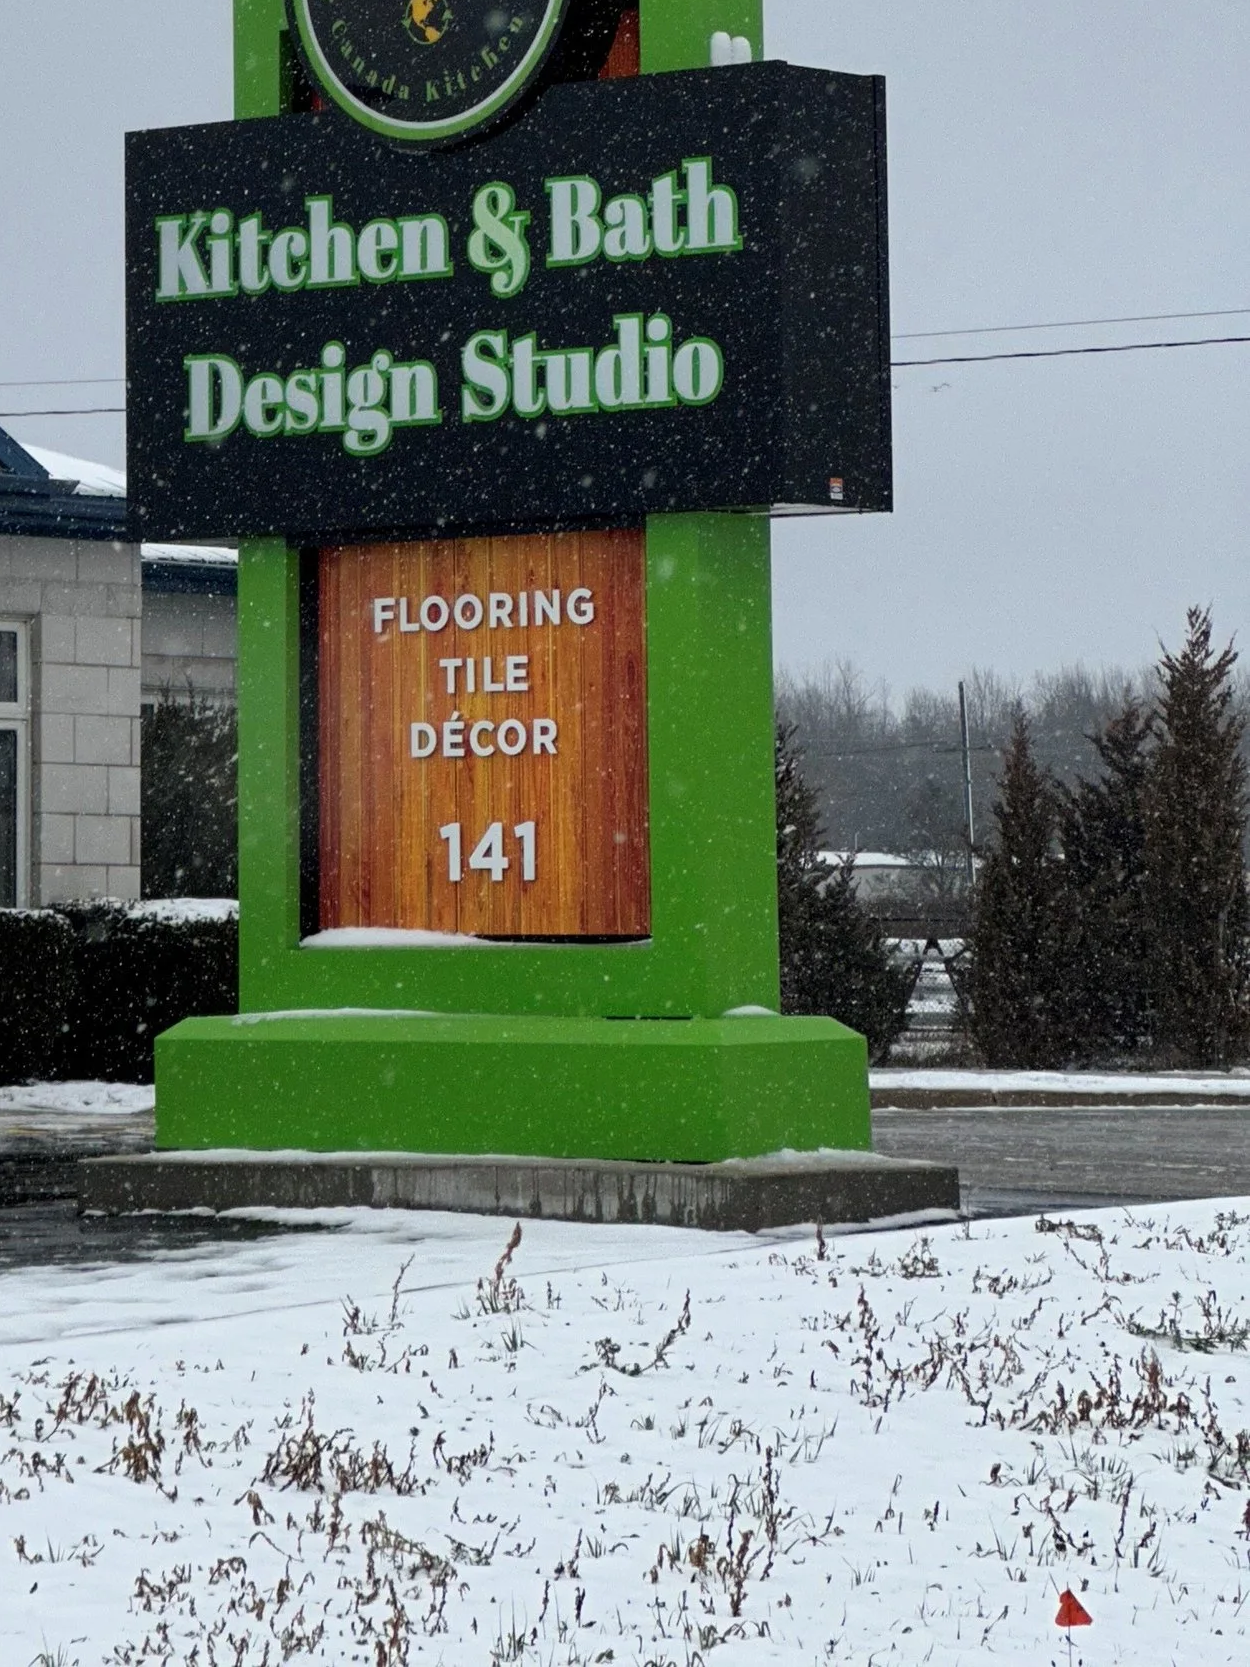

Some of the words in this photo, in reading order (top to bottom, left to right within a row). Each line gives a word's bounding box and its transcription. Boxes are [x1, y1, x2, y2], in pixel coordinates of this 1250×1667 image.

[332, 19, 410, 100] Canada
[426, 16, 523, 102] Kitchen
[155, 194, 453, 302] Kitchen
[467, 180, 530, 299] &
[545, 156, 743, 268] Bath
[184, 340, 442, 456] Design
[461, 312, 724, 423] Studio
[373, 588, 595, 633] FLOORING
[439, 655, 529, 694] TILE
[410, 711, 558, 758] DÉCOR
[439, 821, 536, 881] 141
